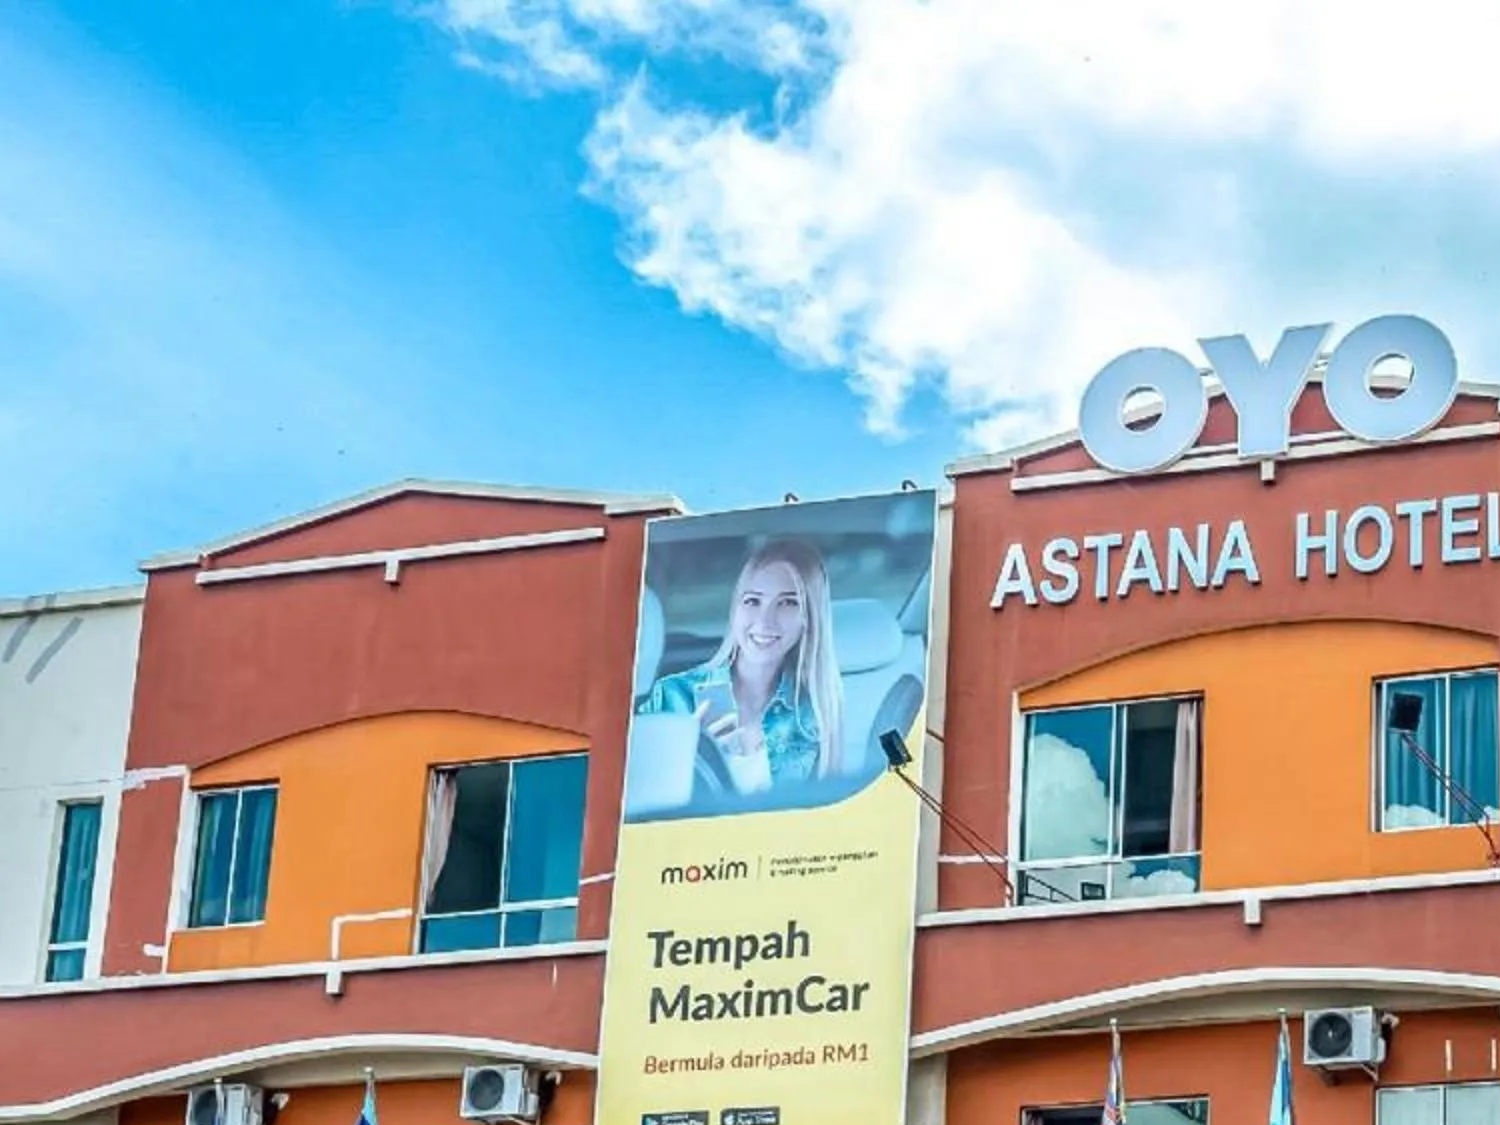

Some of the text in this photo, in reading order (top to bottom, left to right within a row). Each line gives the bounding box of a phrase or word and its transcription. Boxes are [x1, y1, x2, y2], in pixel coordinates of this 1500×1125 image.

[1078, 313, 1460, 474] OYO
[989, 519, 1261, 610] ASTANA
[661, 857, 749, 885] maxim
[647, 919, 811, 971] Tempah
[648, 974, 871, 1025] MaximCar
[643, 1042, 871, 1076] Bermula daripada RM1
